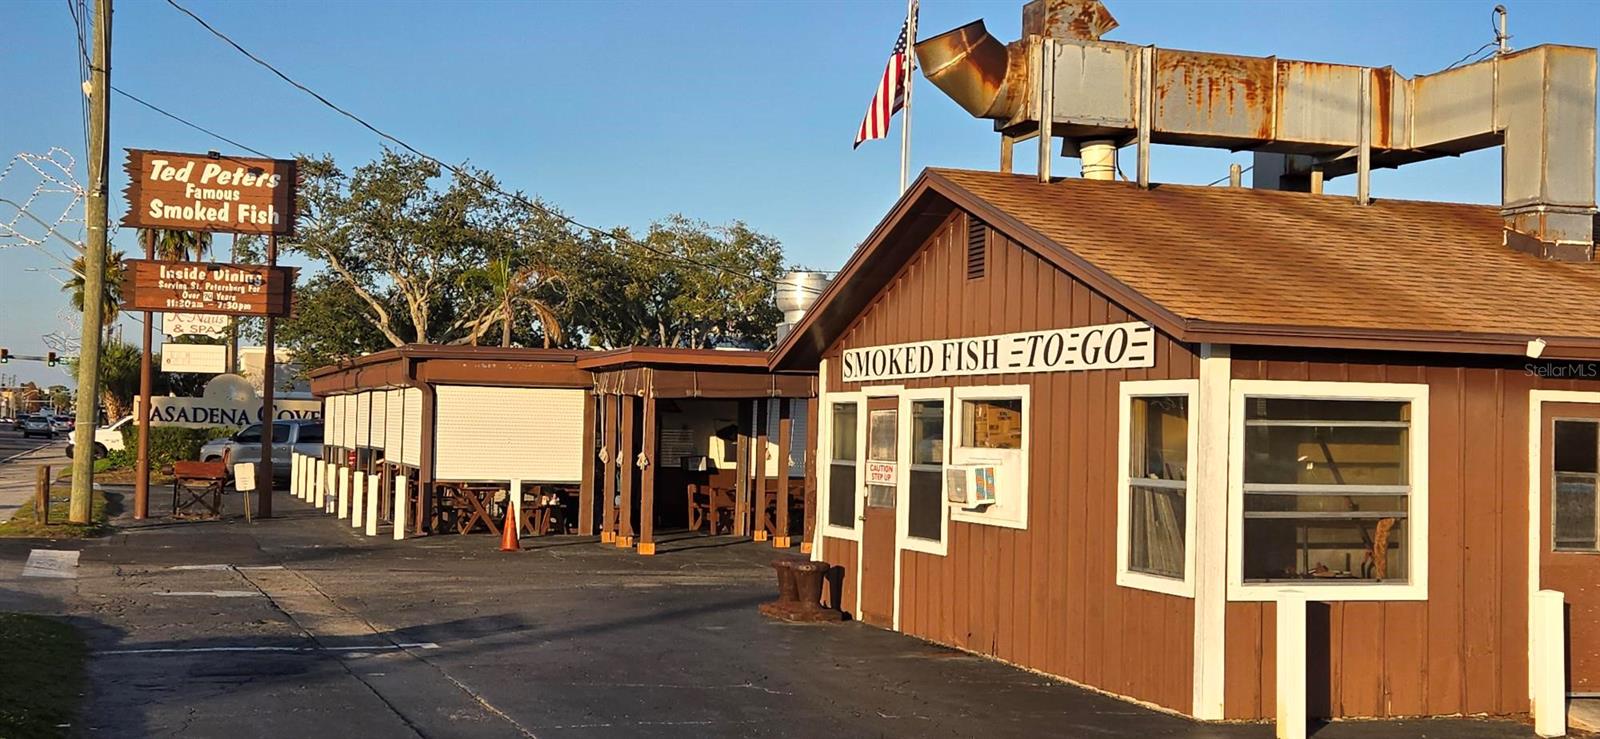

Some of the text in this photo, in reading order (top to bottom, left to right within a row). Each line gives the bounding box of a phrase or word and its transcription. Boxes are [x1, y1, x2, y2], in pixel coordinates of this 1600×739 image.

[150, 160, 281, 188] Ted Peters
[185, 183, 240, 201] Famous
[149, 198, 280, 224] Smoked Fish
[160, 265, 206, 280] Inside
[158, 280, 187, 290] Serving
[205, 282, 245, 294] Petersburg
[248, 285, 260, 293] For
[182, 291, 200, 299] Over
[216, 292, 236, 301] Years
[217, 301, 251, 311] 7:30pm
[173, 324, 215, 334] & SPA
[843, 345, 934, 378] SMOKED
[942, 339, 999, 371] FISH
[137, 401, 252, 425] ASADENA
[870, 464, 894, 473] CAUTION
[871, 472, 892, 481] STEP UP
